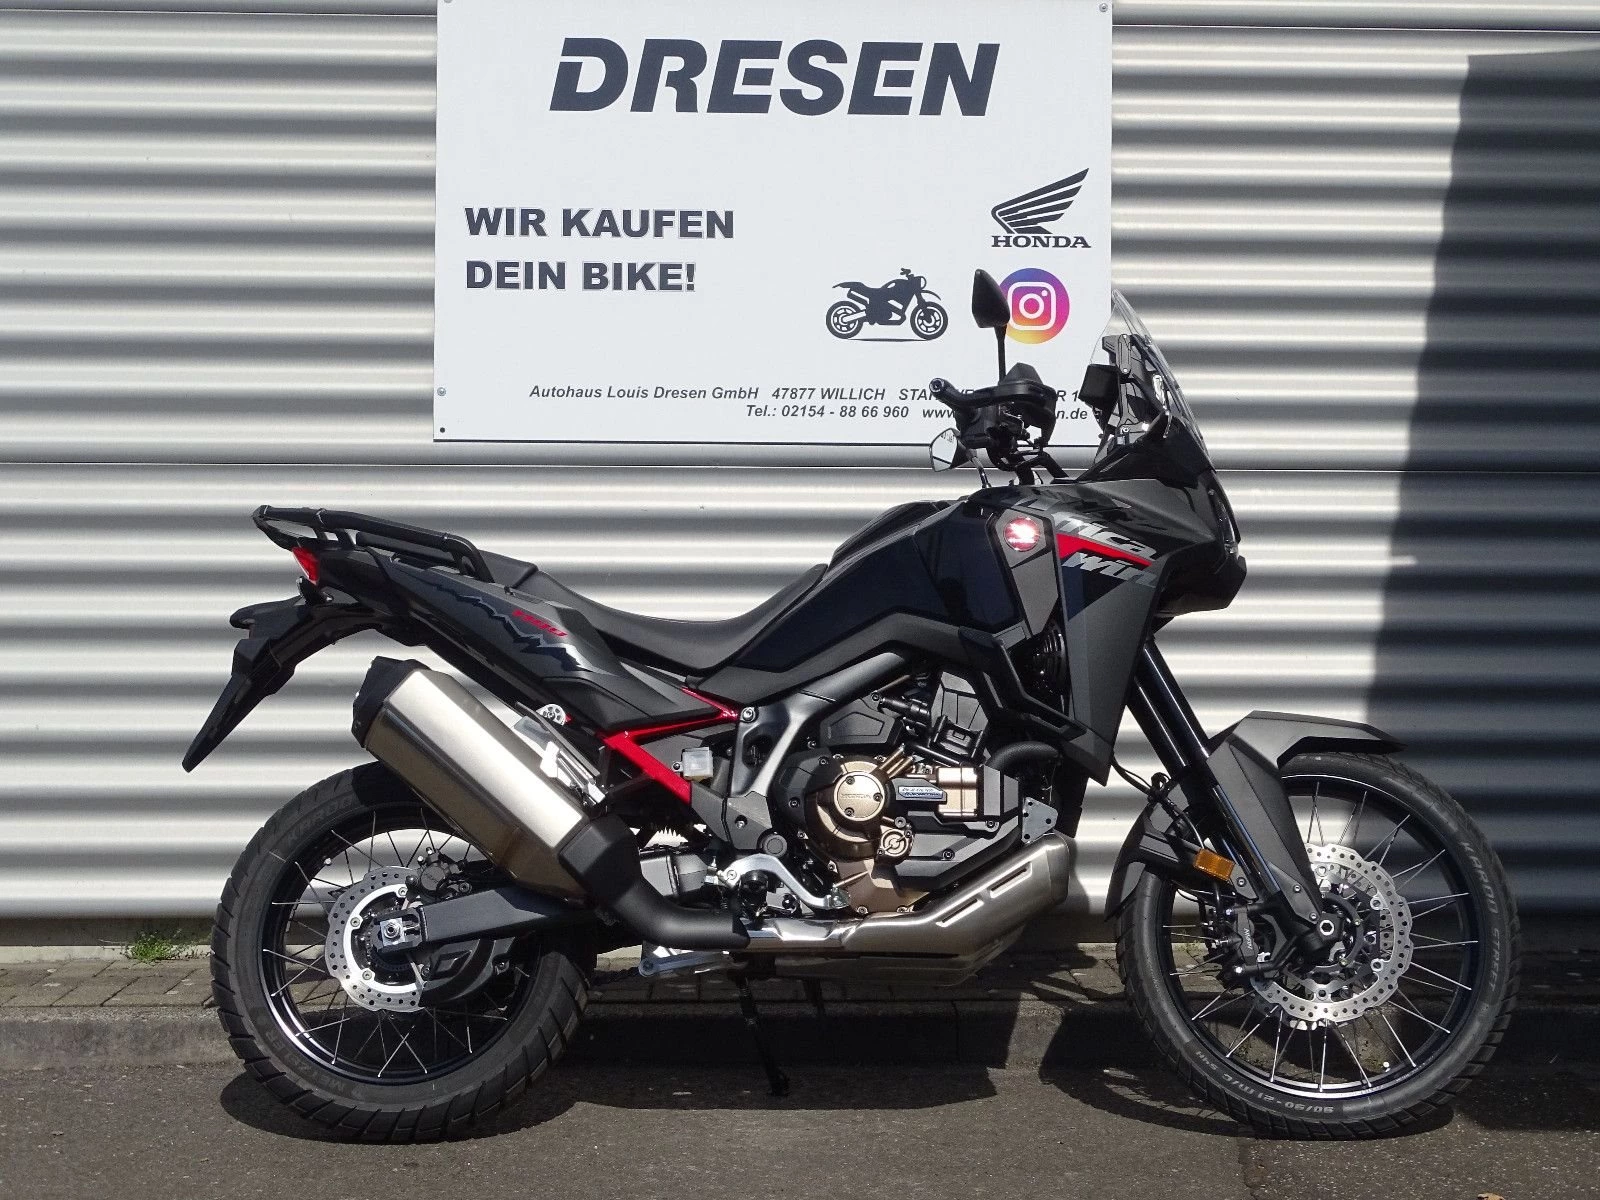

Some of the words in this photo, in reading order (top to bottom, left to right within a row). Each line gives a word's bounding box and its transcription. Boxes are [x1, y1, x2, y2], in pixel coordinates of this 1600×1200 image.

[549, 37, 1001, 117] DRESEN
[464, 207, 548, 237] WIR
[562, 208, 734, 239] KAUFEN
[991, 235, 1092, 249] HONDA
[466, 260, 566, 290] DEIN
[582, 262, 696, 293] BIKE!
[529, 385, 603, 398] Autohaus
[606, 386, 649, 399] Louis
[653, 386, 707, 399] Dresen
[711, 387, 760, 400] GmbH
[771, 387, 817, 400] 47877
[820, 387, 886, 401] WILLICH
[746, 404, 777, 417] Tel.:
[781, 404, 825, 418] 02154
[839, 405, 857, 418] 88
[861, 405, 879, 418] 66
[882, 405, 910, 418] 960
